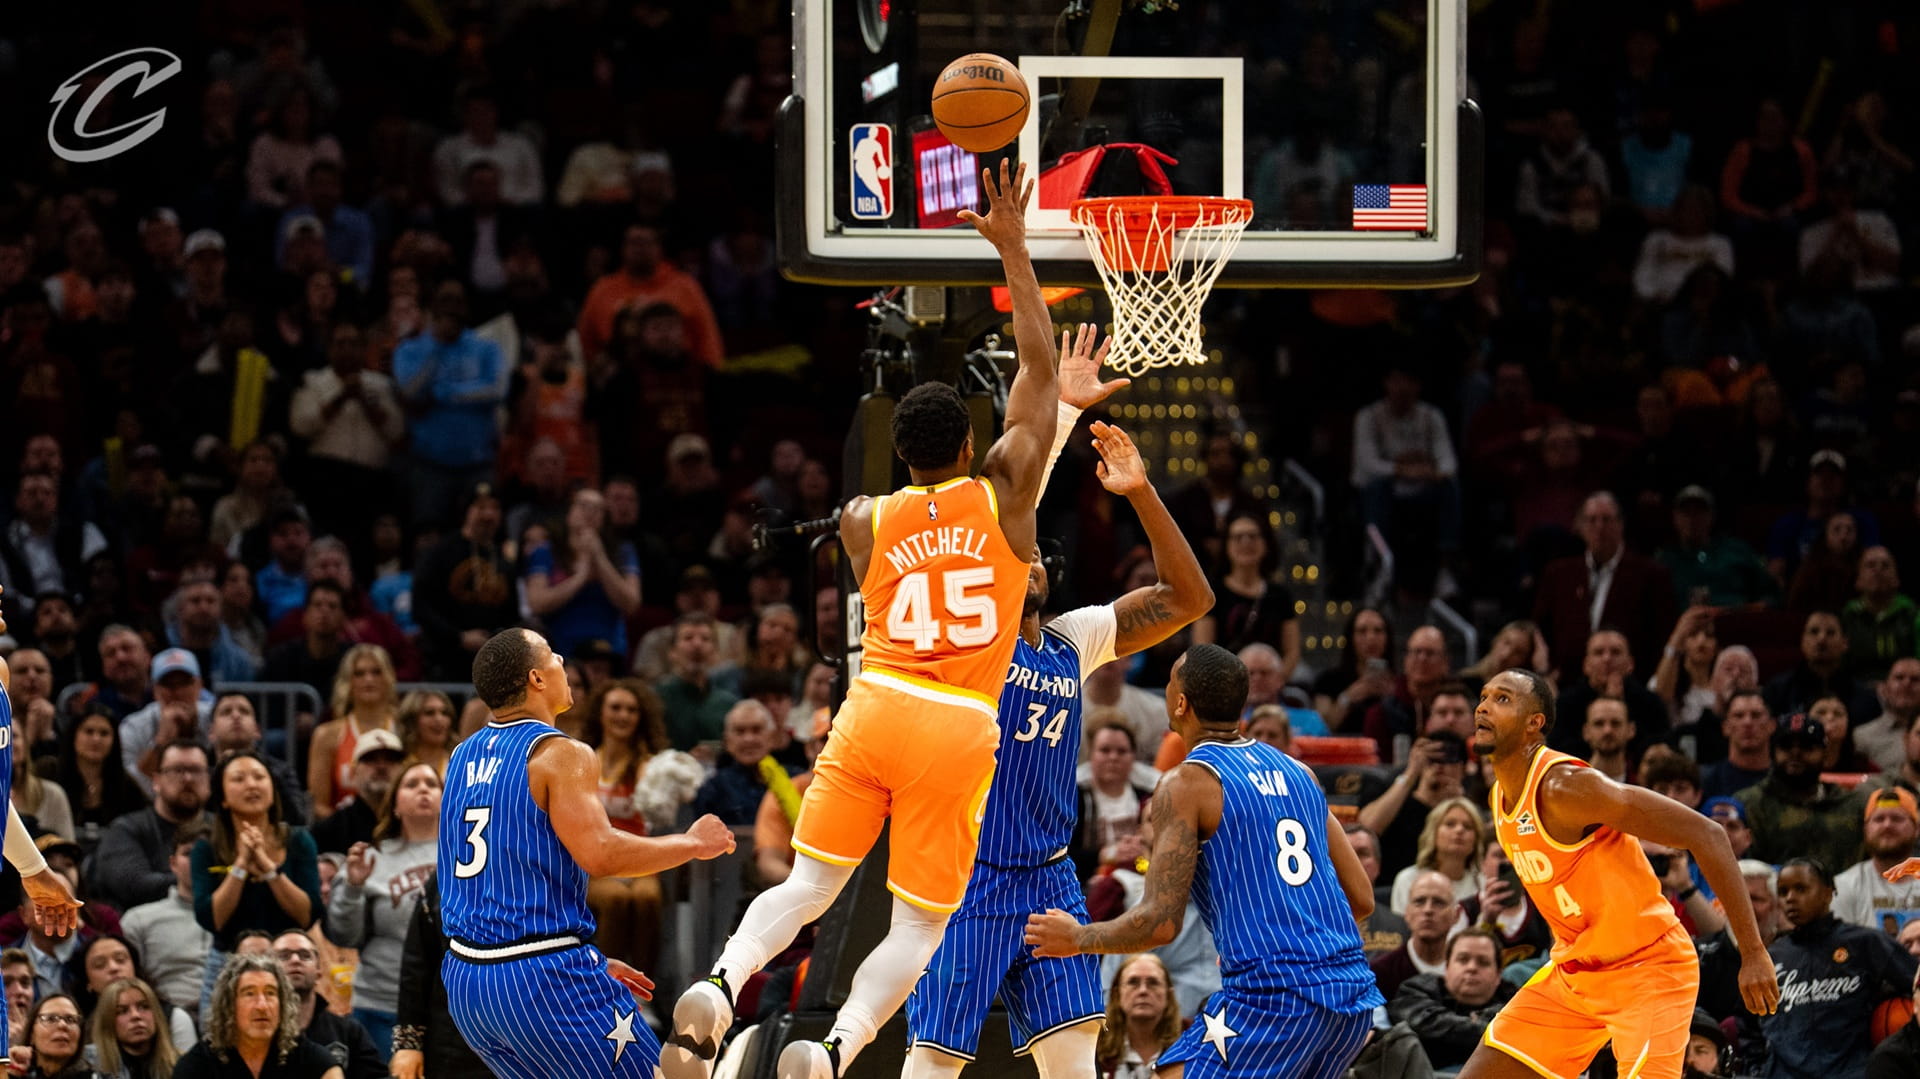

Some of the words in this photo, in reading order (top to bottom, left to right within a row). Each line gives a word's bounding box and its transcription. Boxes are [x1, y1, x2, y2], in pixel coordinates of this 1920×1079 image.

[943, 65, 1005, 83] Wilson
[856, 197, 879, 213] NBA
[884, 526, 988, 575] MITCHELL
[886, 566, 999, 653] 45
[1004, 662, 1079, 699] ORLND
[1013, 702, 1069, 748] 34
[454, 806, 491, 879] 3
[1276, 817, 1314, 887] 8
[1554, 883, 1582, 917] 4
[1777, 968, 1861, 1013] Supreme
